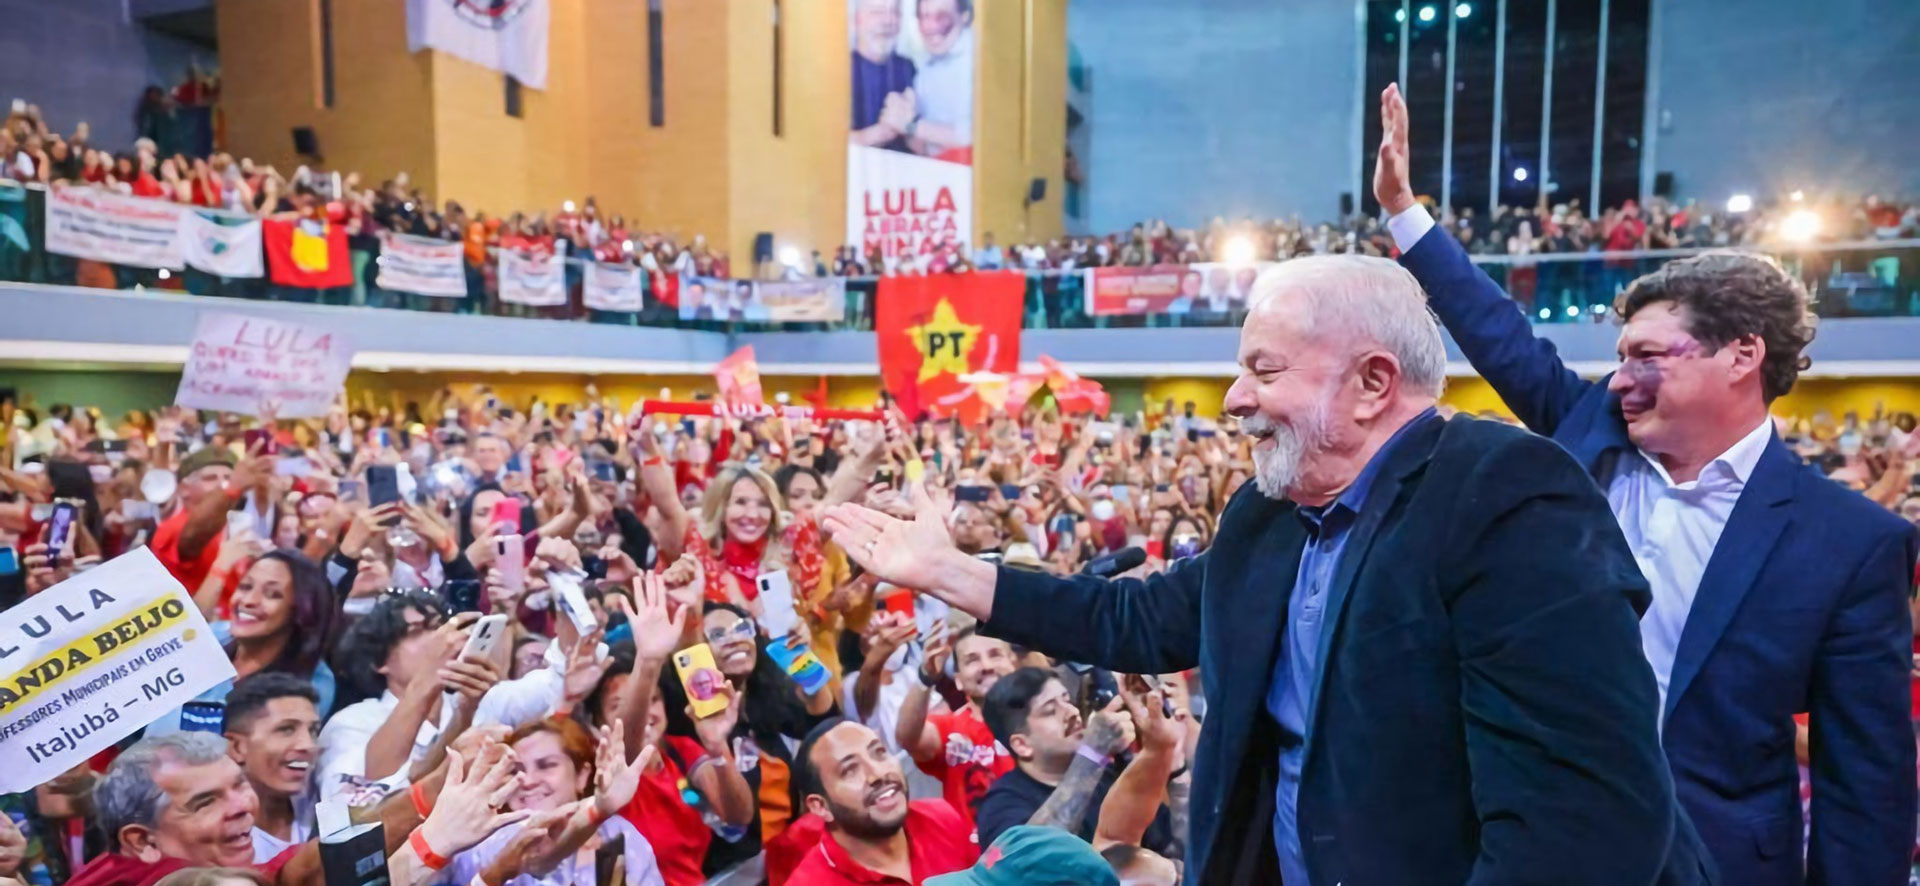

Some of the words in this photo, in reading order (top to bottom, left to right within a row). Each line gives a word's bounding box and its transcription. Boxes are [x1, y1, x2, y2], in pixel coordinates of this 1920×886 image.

[863, 187, 957, 216] LULA
[234, 320, 332, 354] LULA
[929, 332, 965, 357] PT
[0, 588, 116, 659] LULA
[0, 648, 93, 710] ANDA
[93, 599, 185, 656] BEIJO
[26, 703, 120, 763] Itajubá
[141, 667, 185, 702] MG
